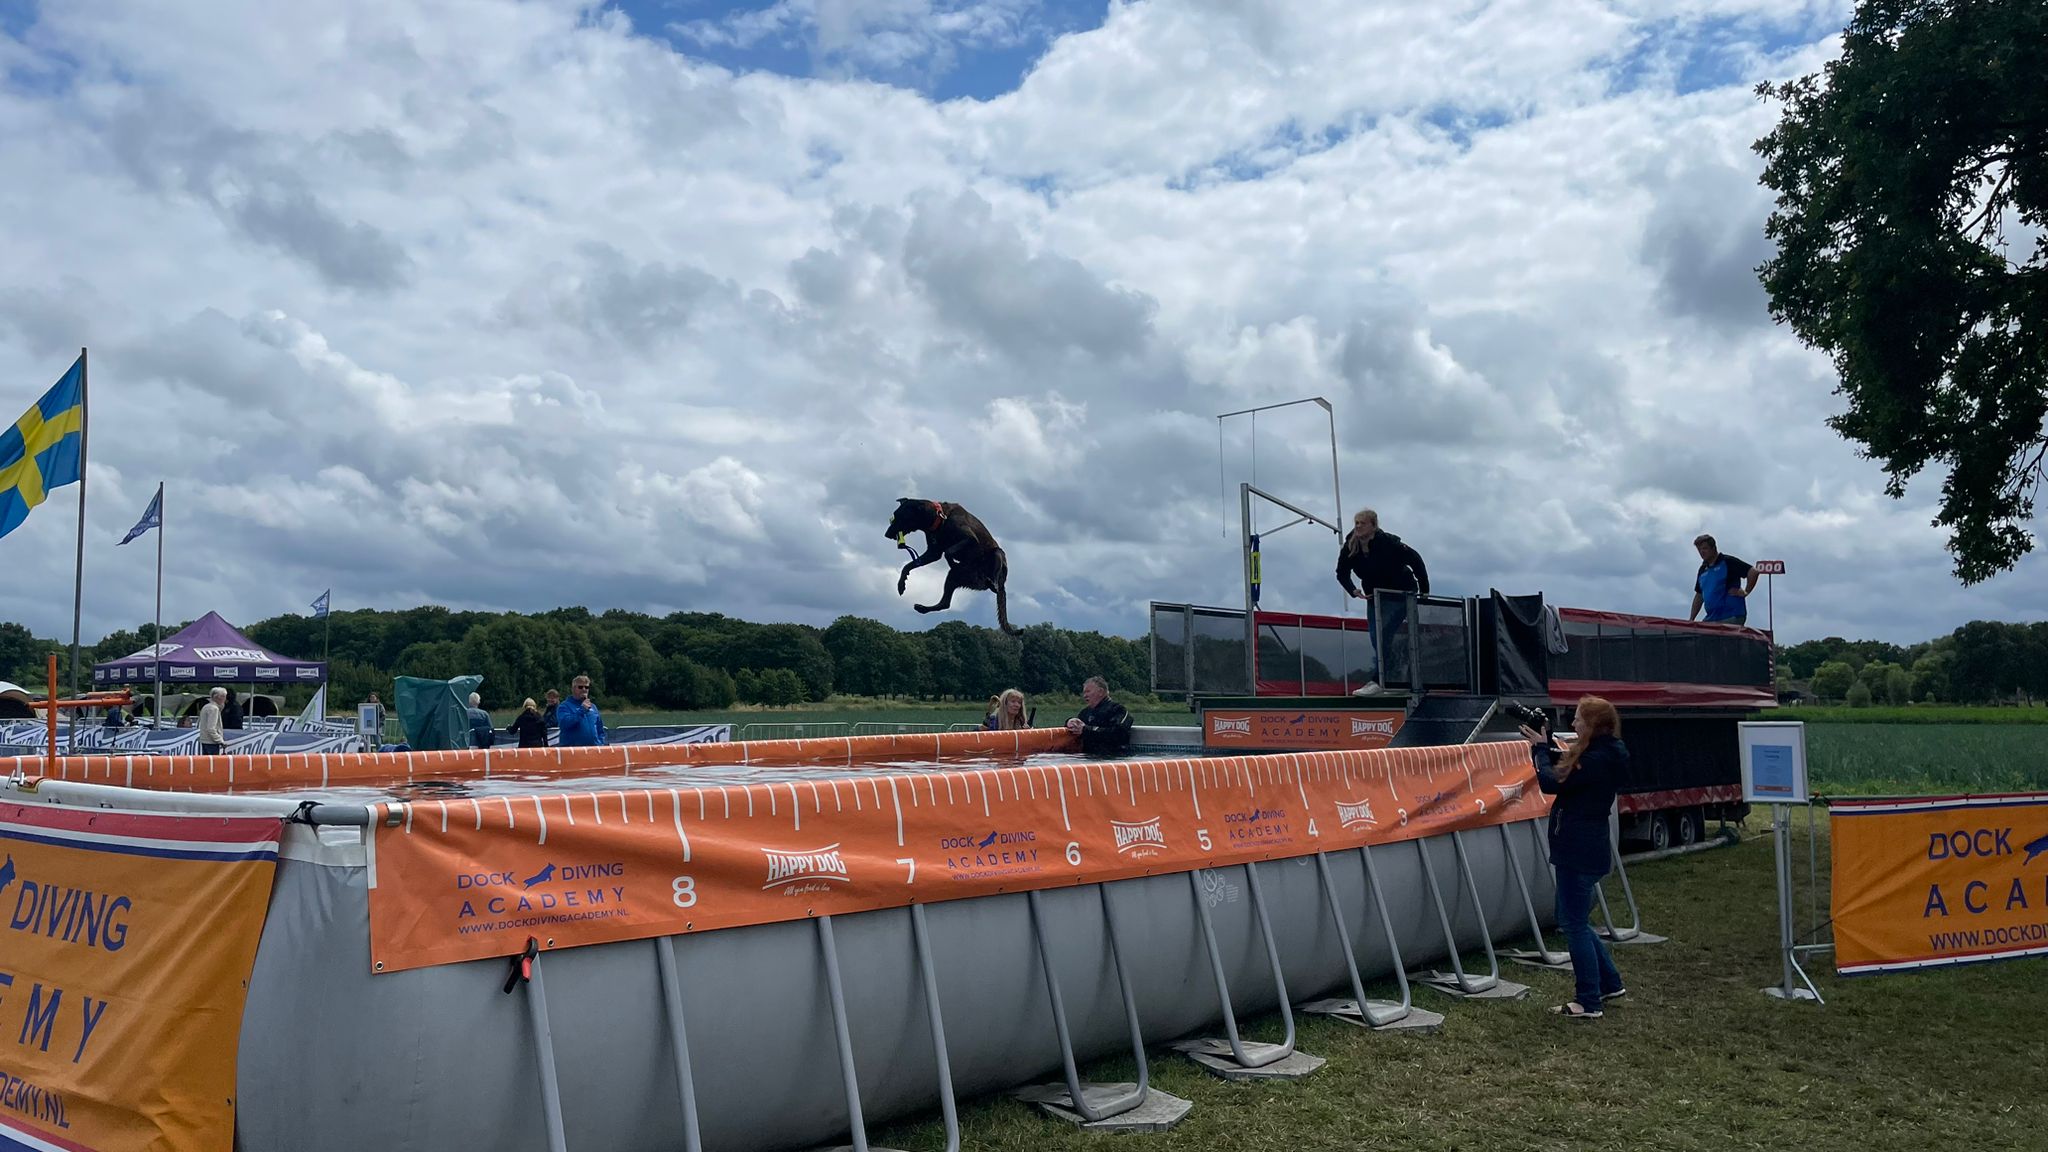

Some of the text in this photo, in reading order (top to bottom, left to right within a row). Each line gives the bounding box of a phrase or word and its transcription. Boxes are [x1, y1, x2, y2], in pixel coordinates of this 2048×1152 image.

[201, 647, 263, 660] HAPPY CAT
[1214, 719, 1250, 732] HAPPY DOG
[1260, 715, 1286, 723] DOCK
[1351, 720, 1393, 734] HAPPY DOG
[1261, 728, 1340, 736] ACADEMY
[1224, 809, 1286, 823] DOCK DIVING
[1337, 802, 1375, 823] HAPPY DOG
[1398, 808, 1407, 826] 3
[1475, 799, 1487, 814] 2
[1112, 822, 1164, 848] HAPPY DOG
[1229, 824, 1289, 840] ACADEMY
[1308, 818, 1319, 837] 4
[941, 831, 1035, 849] DOCK DIVING
[1197, 829, 1212, 851] 5
[1928, 828, 2013, 860] DOCK
[948, 849, 1038, 869] ACADEMY
[1065, 841, 1081, 867] 6
[457, 863, 624, 889] DOCK DIVING
[766, 850, 847, 882] HAPPY DOG
[896, 858, 915, 884] 7
[458, 887, 625, 918] ACADEMY
[671, 876, 698, 908] 8
[1923, 875, 2048, 918] ACA
[10, 880, 132, 951] DIVING
[458, 909, 630, 934] WWW.DOCKDIVINGACADEMY.NL
